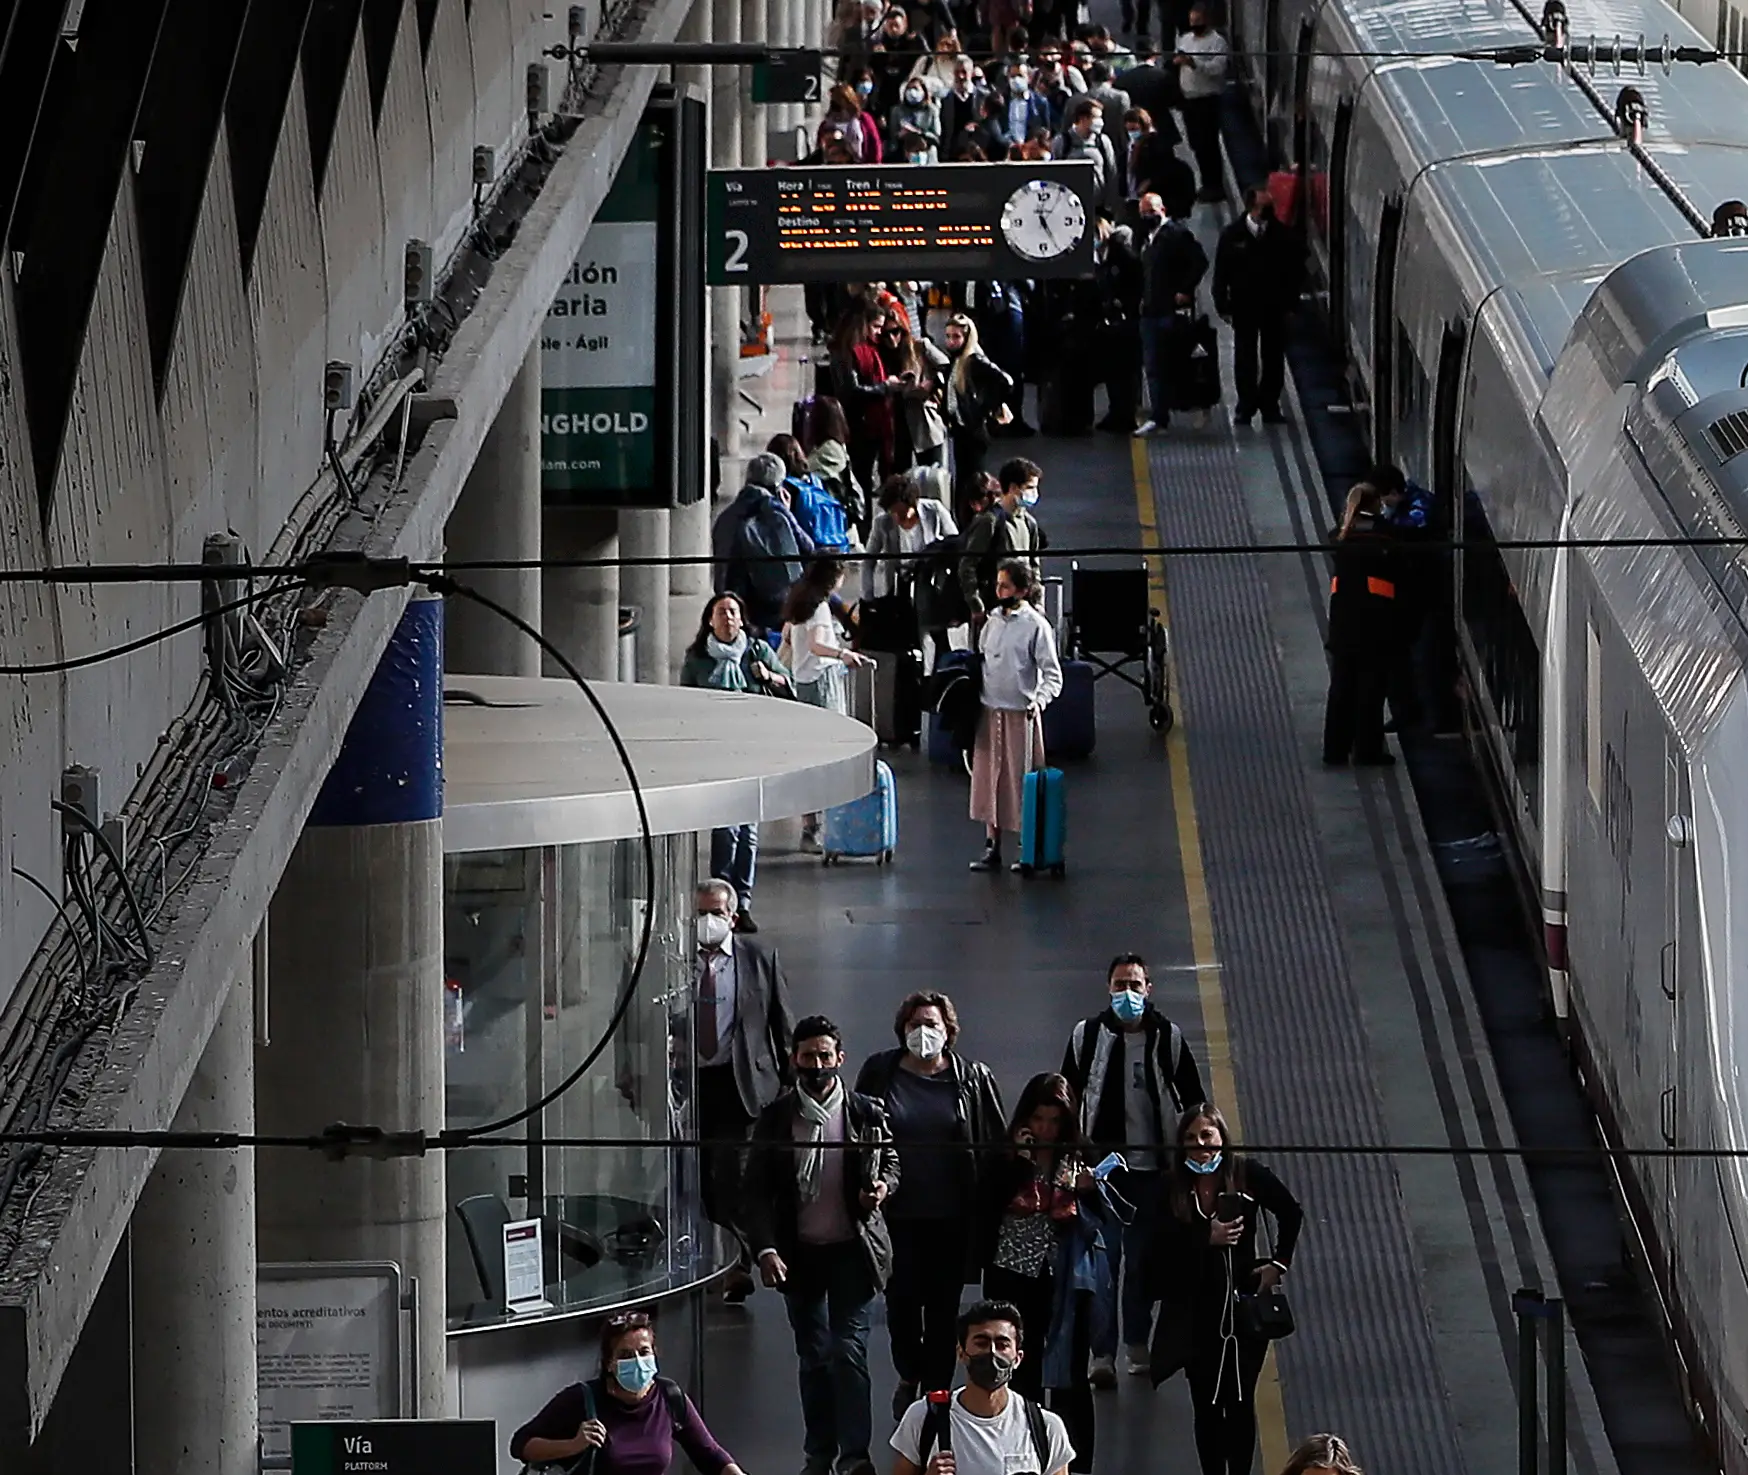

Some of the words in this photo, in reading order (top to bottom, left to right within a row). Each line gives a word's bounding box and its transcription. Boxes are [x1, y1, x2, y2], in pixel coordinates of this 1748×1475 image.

[804, 75, 818, 99] 2
[778, 180, 804, 191] Hora
[846, 179, 870, 190] Tren
[778, 215, 820, 227] Destino
[724, 229, 749, 272] 2
[547, 294, 607, 317] aria
[576, 334, 609, 350] Ágil
[292, 1305, 366, 1318] acreditativos
[344, 1435, 373, 1454] Vía
[344, 1461, 389, 1471] PLATFORM
